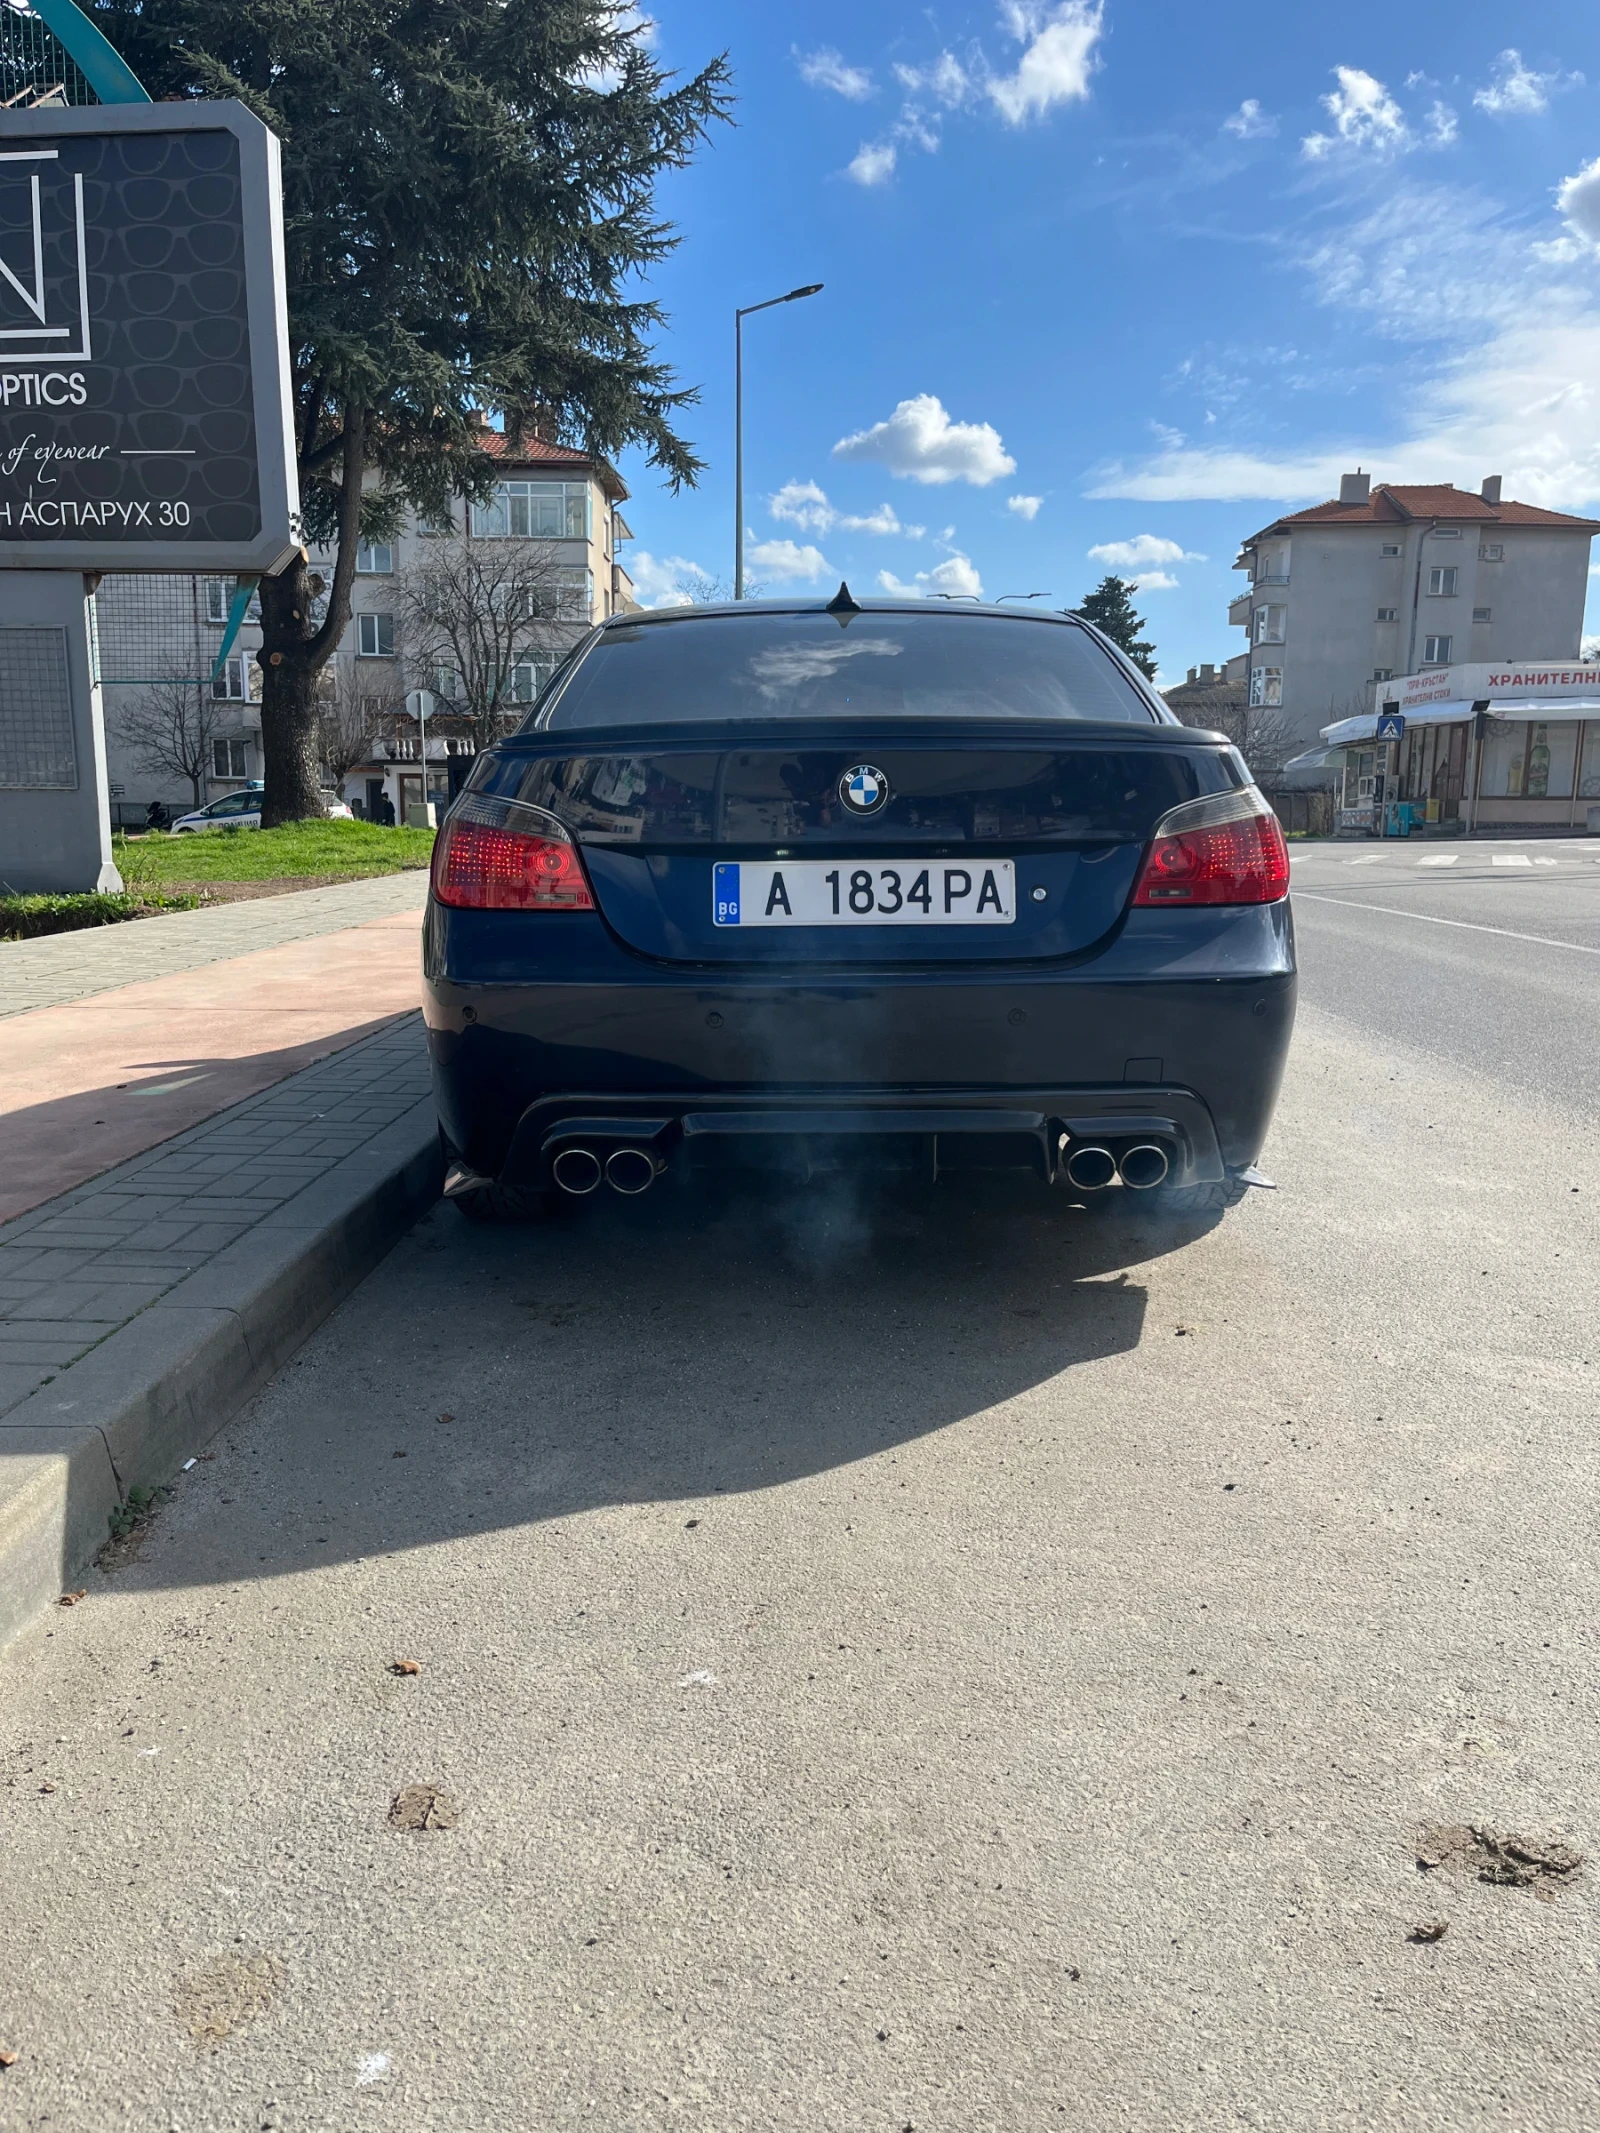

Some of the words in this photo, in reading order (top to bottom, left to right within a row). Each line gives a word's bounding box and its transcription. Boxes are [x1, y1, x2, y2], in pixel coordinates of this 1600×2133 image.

[0, 372, 87, 406] PTICS
[1, 433, 36, 476] of
[34, 440, 110, 484] eyewear
[19, 501, 153, 526] АСПАРУХ
[159, 501, 190, 526] 30
[1488, 672, 1600, 686] ХРАНИТЕЛН
[845, 767, 883, 783] BMW
[718, 902, 738, 916] BG
